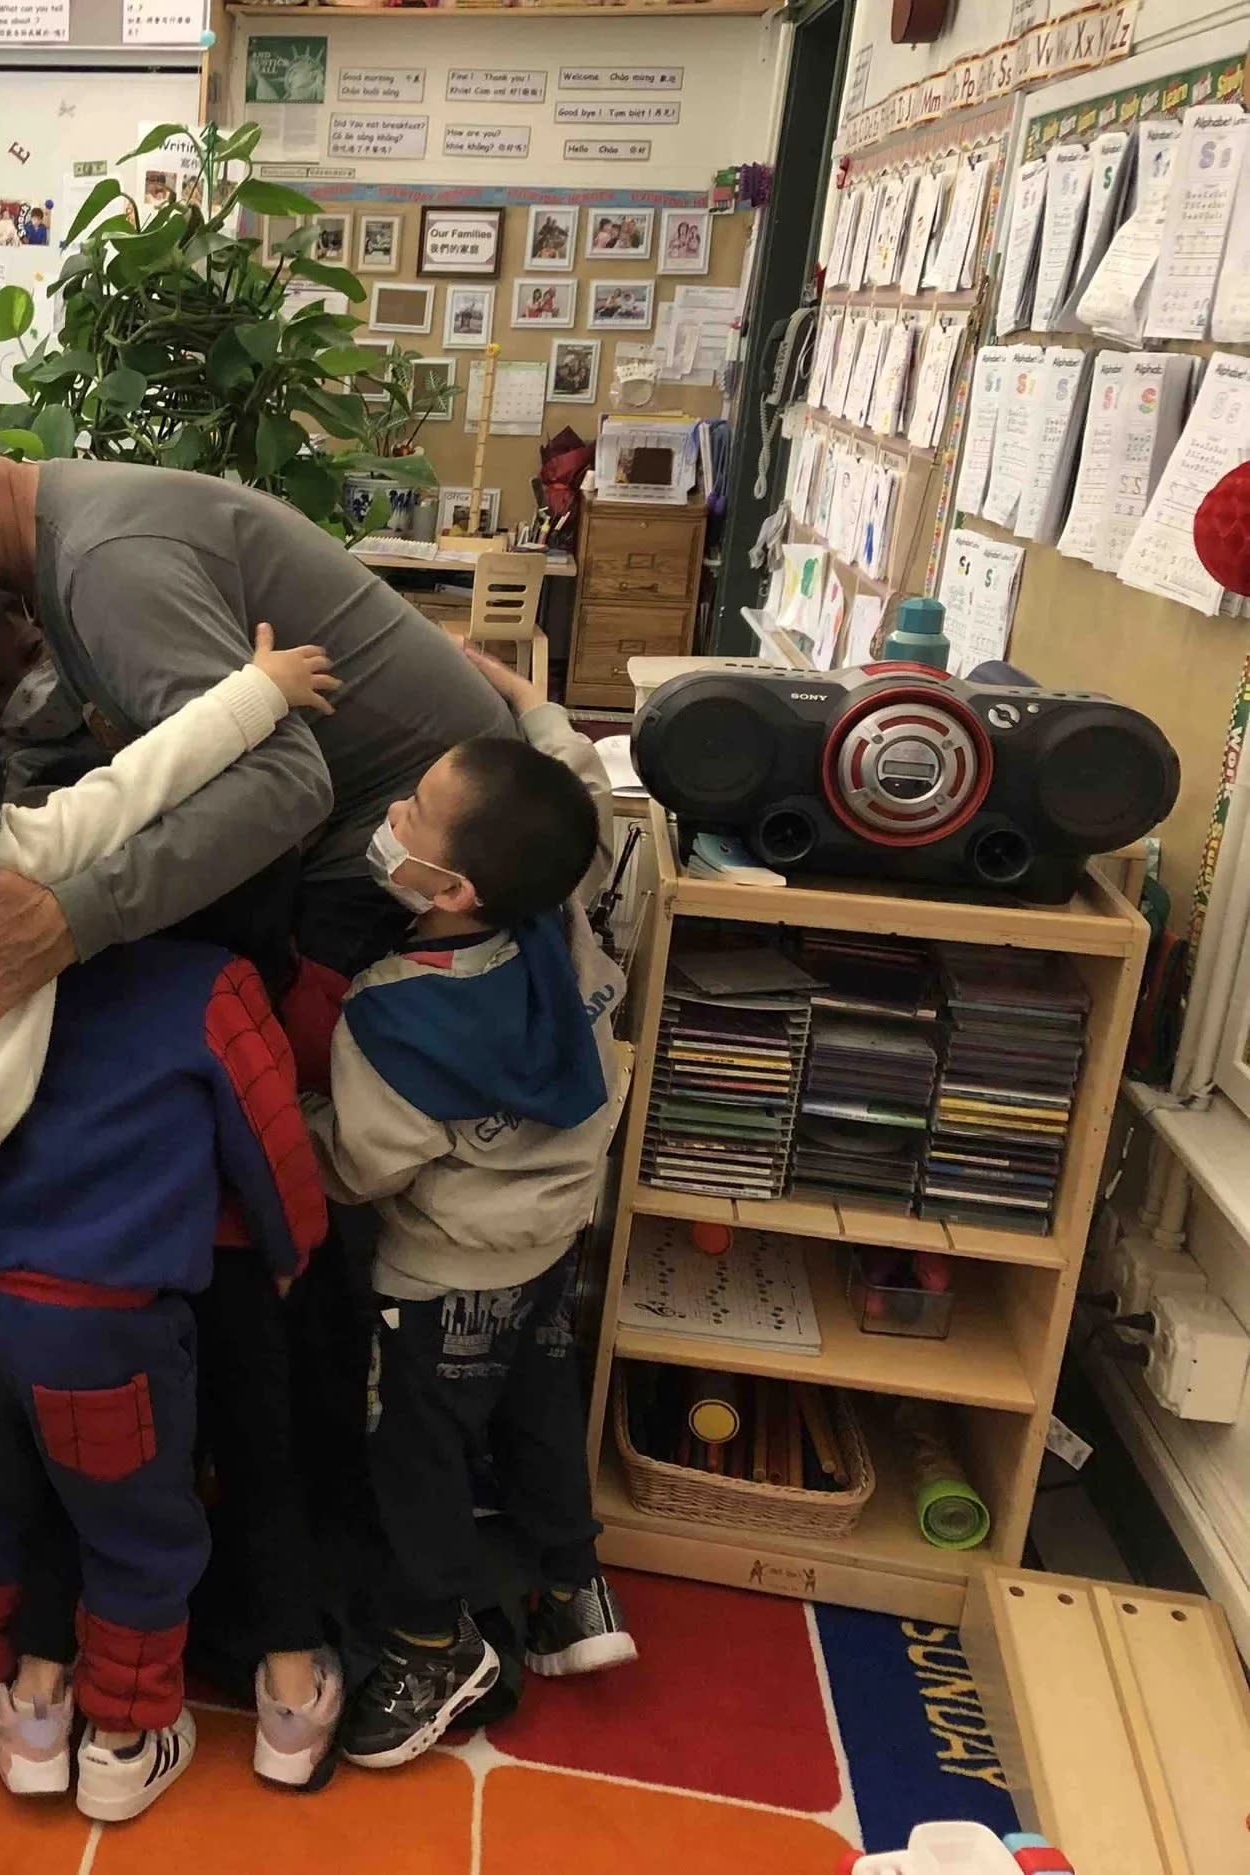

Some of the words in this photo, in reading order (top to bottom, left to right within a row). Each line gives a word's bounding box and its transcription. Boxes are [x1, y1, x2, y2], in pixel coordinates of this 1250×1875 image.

[485, 72, 508, 81] Thank
[563, 72, 599, 81] Welcome
[998, 54, 1012, 88] Ss
[342, 72, 361, 81] Good
[364, 75, 394, 84] morning
[558, 107, 578, 116] Good
[483, 129, 501, 140] you?
[8, 141, 31, 165] E
[568, 145, 589, 153] Hello
[430, 228, 450, 239] Our
[451, 228, 493, 239] Families
[790, 692, 828, 701] SONY
[1224, 726, 1242, 800] Work
[900, 1620, 1010, 1790] SUNDAY
